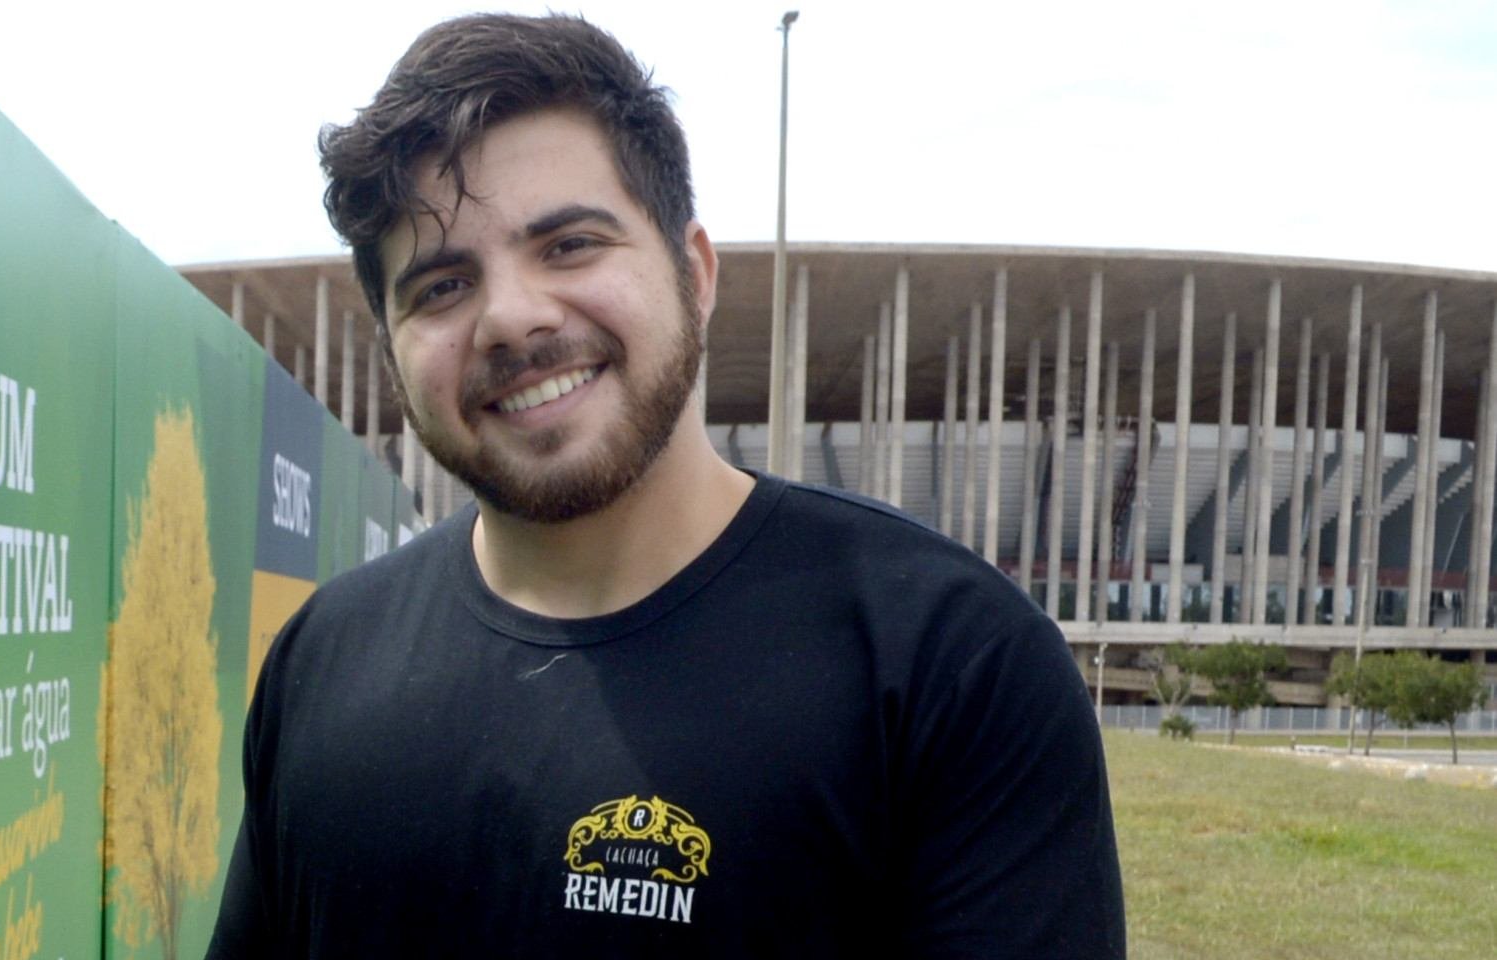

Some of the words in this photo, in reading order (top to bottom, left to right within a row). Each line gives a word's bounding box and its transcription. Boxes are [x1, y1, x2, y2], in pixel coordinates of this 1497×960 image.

[21, 650, 71, 779] água
[633, 809, 646, 827] R
[605, 846, 660, 868] CACHAÇA
[564, 872, 695, 924] REMEDIN
